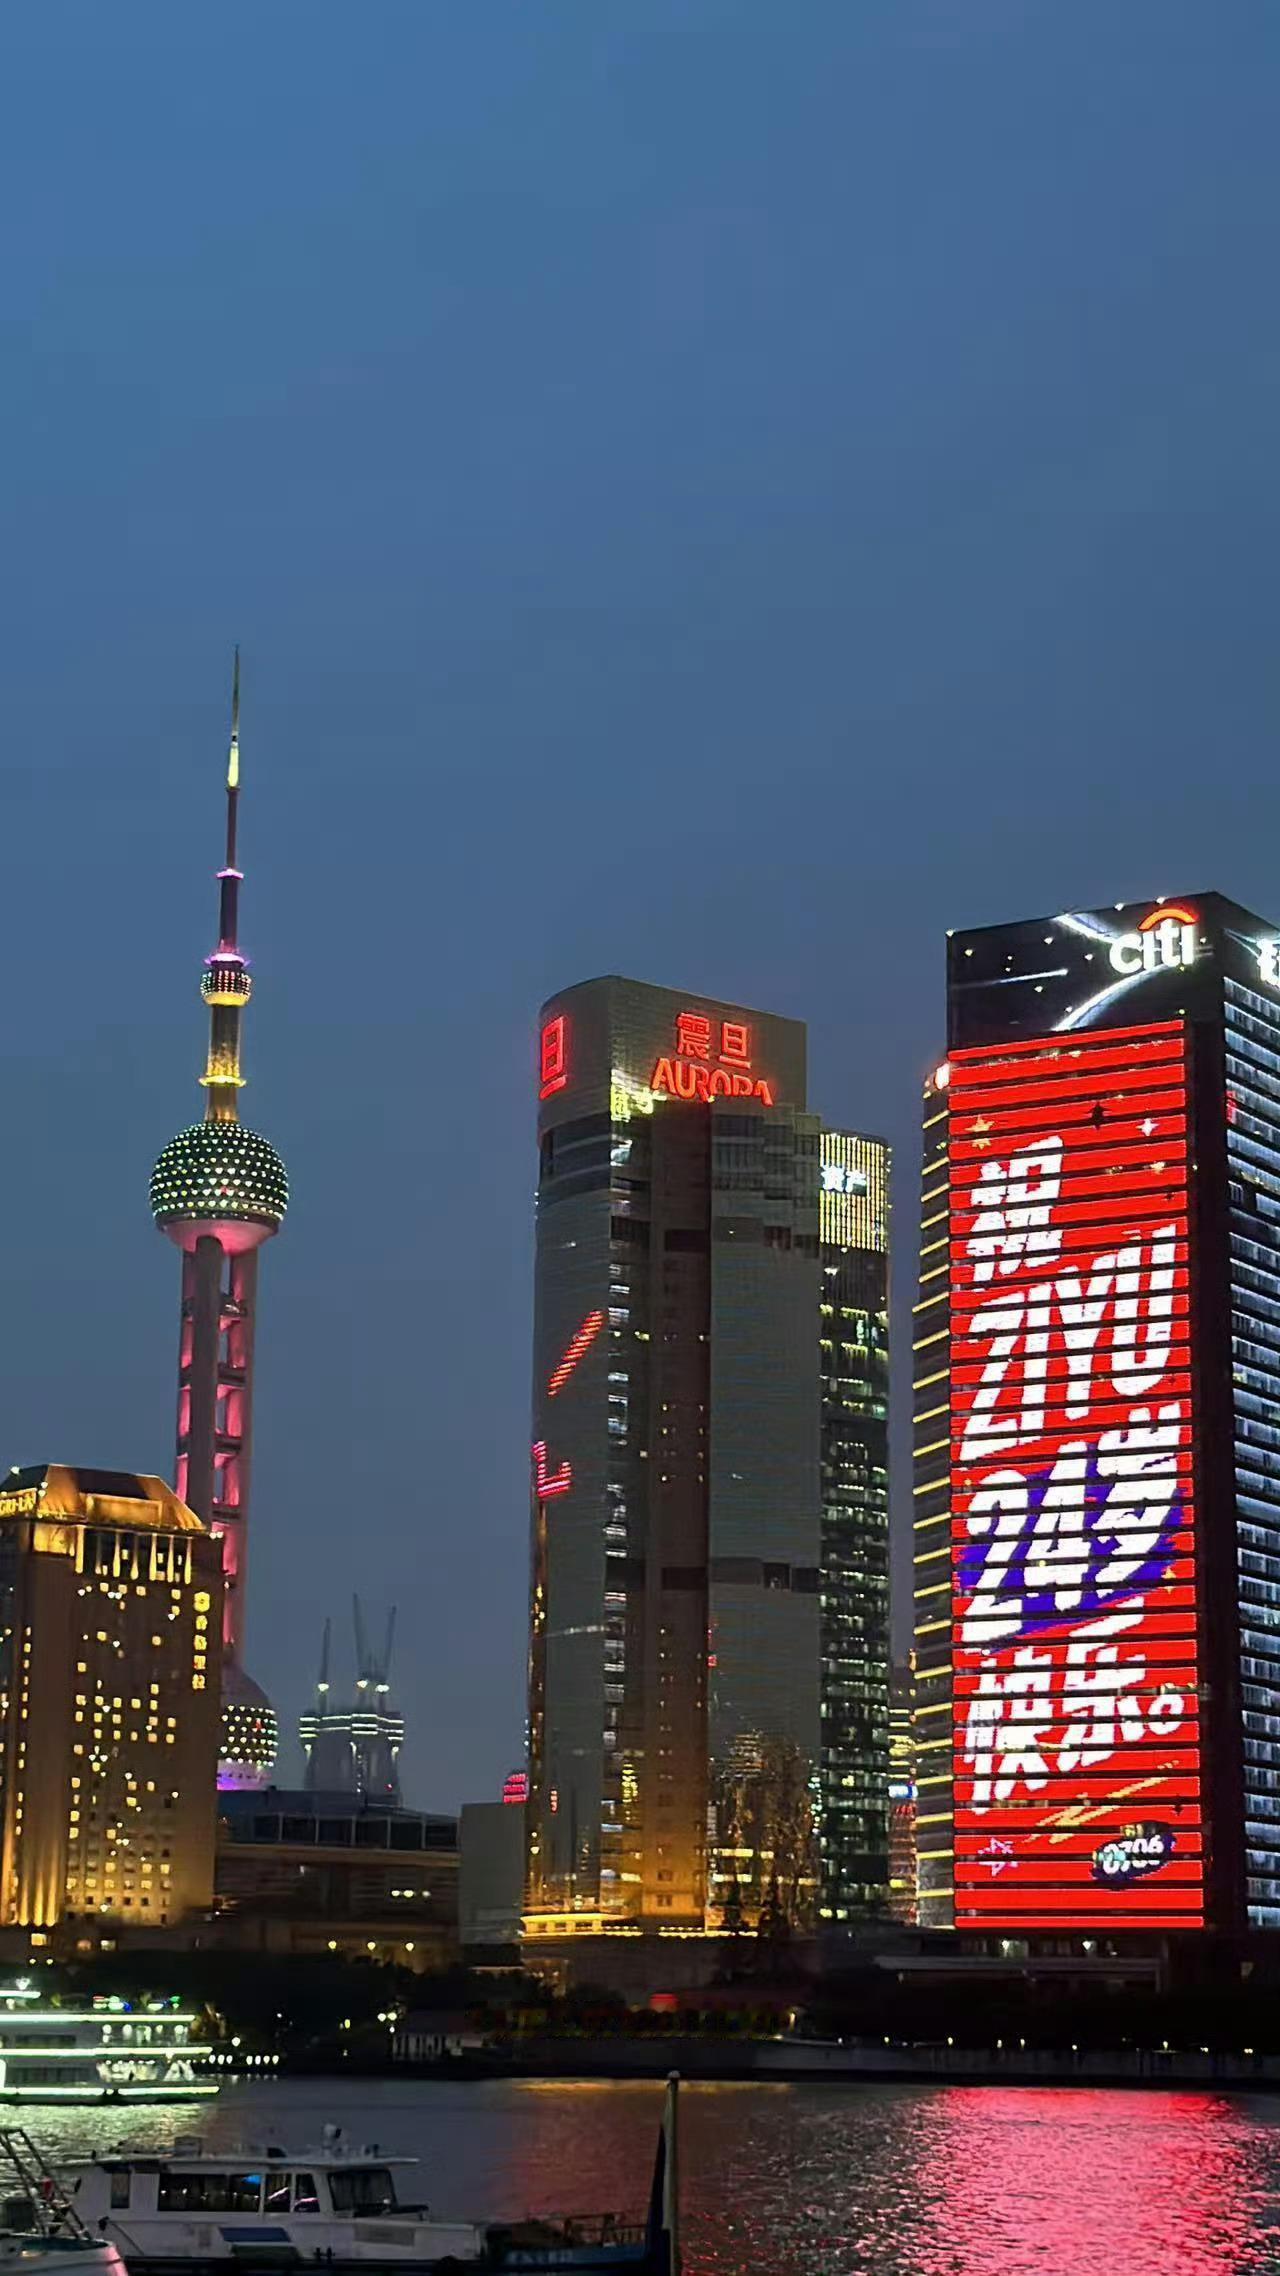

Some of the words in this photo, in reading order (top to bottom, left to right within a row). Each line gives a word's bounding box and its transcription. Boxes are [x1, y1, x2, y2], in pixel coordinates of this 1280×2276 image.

[1109, 917, 1195, 974] citi
[676, 1011, 752, 1070] 震旦
[959, 1223, 1177, 1461] ZIYU
